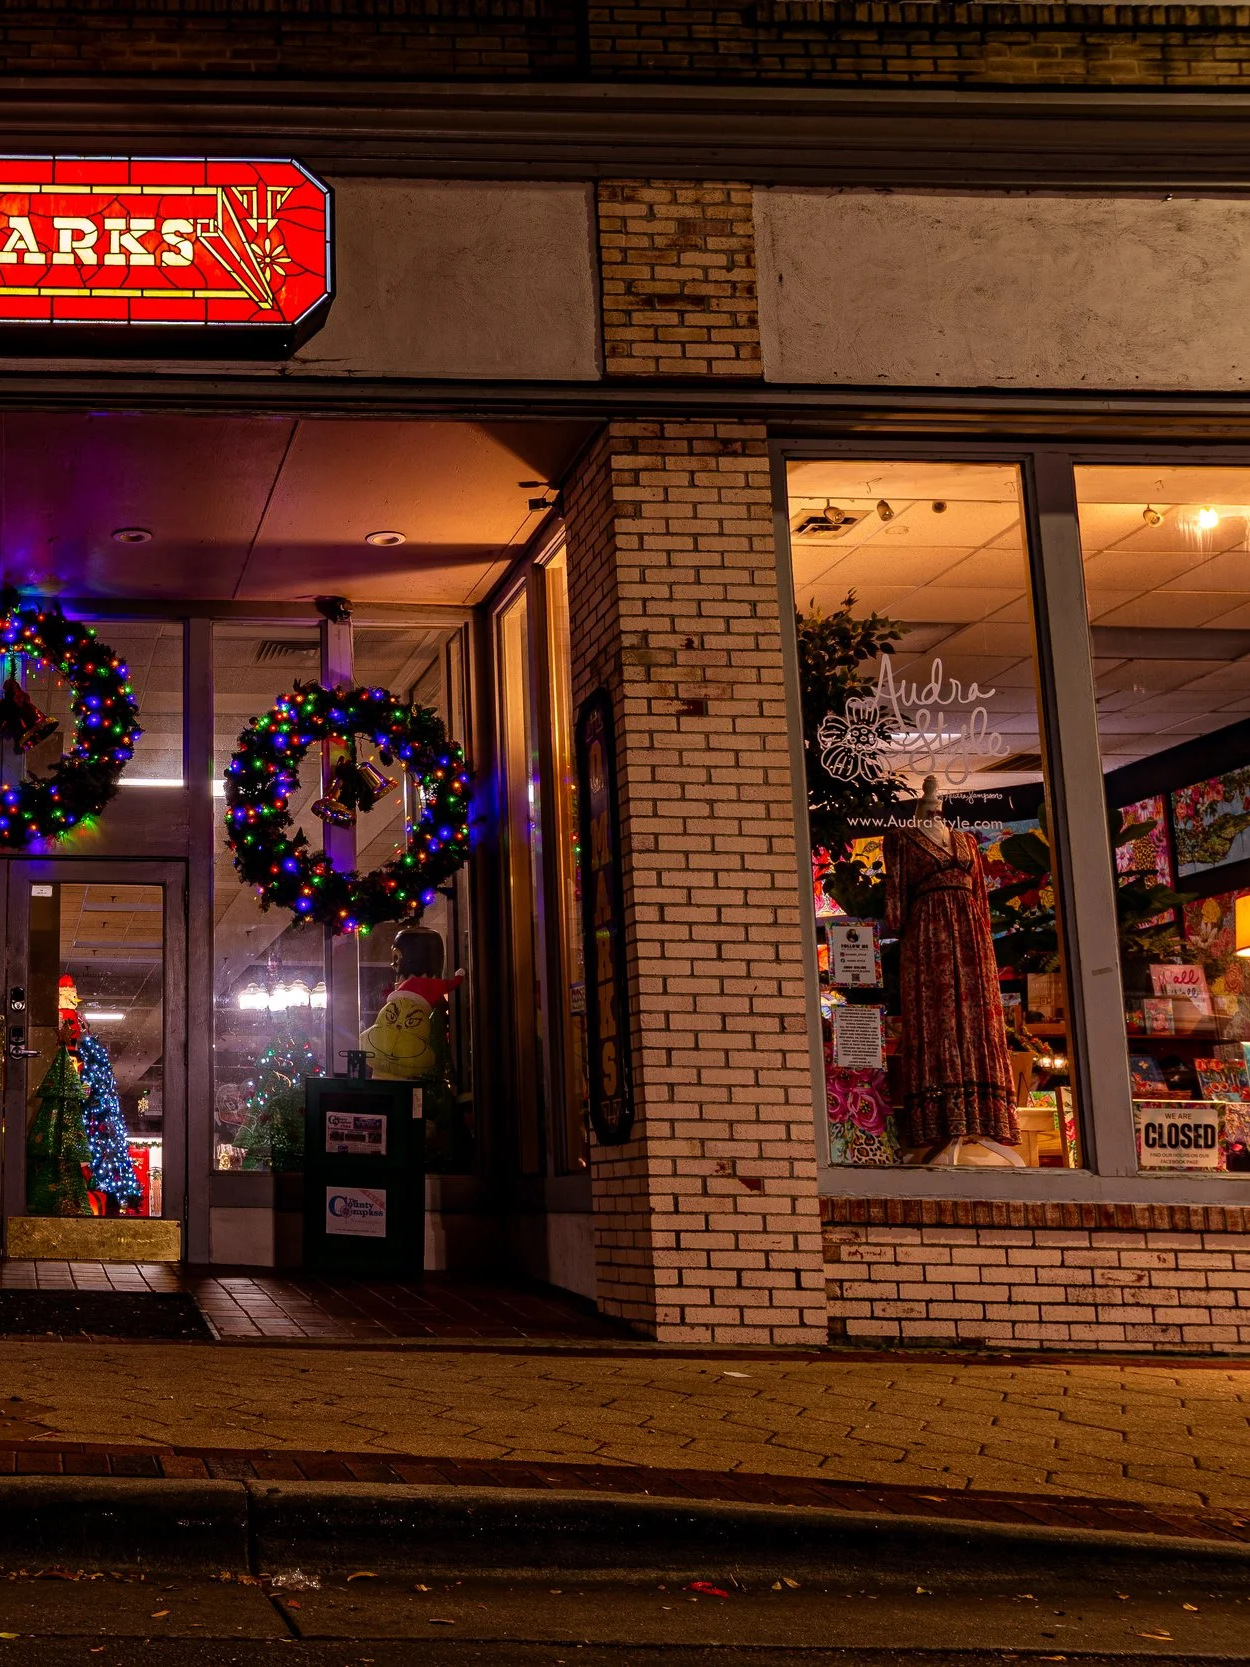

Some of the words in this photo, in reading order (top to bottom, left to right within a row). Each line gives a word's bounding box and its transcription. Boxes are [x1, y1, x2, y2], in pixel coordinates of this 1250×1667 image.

[873, 654, 996, 730] Audra
[898, 707, 1011, 785] Style
[846, 815, 1003, 833] www.AudraStyle.com
[1164, 1112, 1176, 1120] WE
[1177, 1112, 1193, 1120] ARE
[1144, 1122, 1216, 1149] CLOSED
